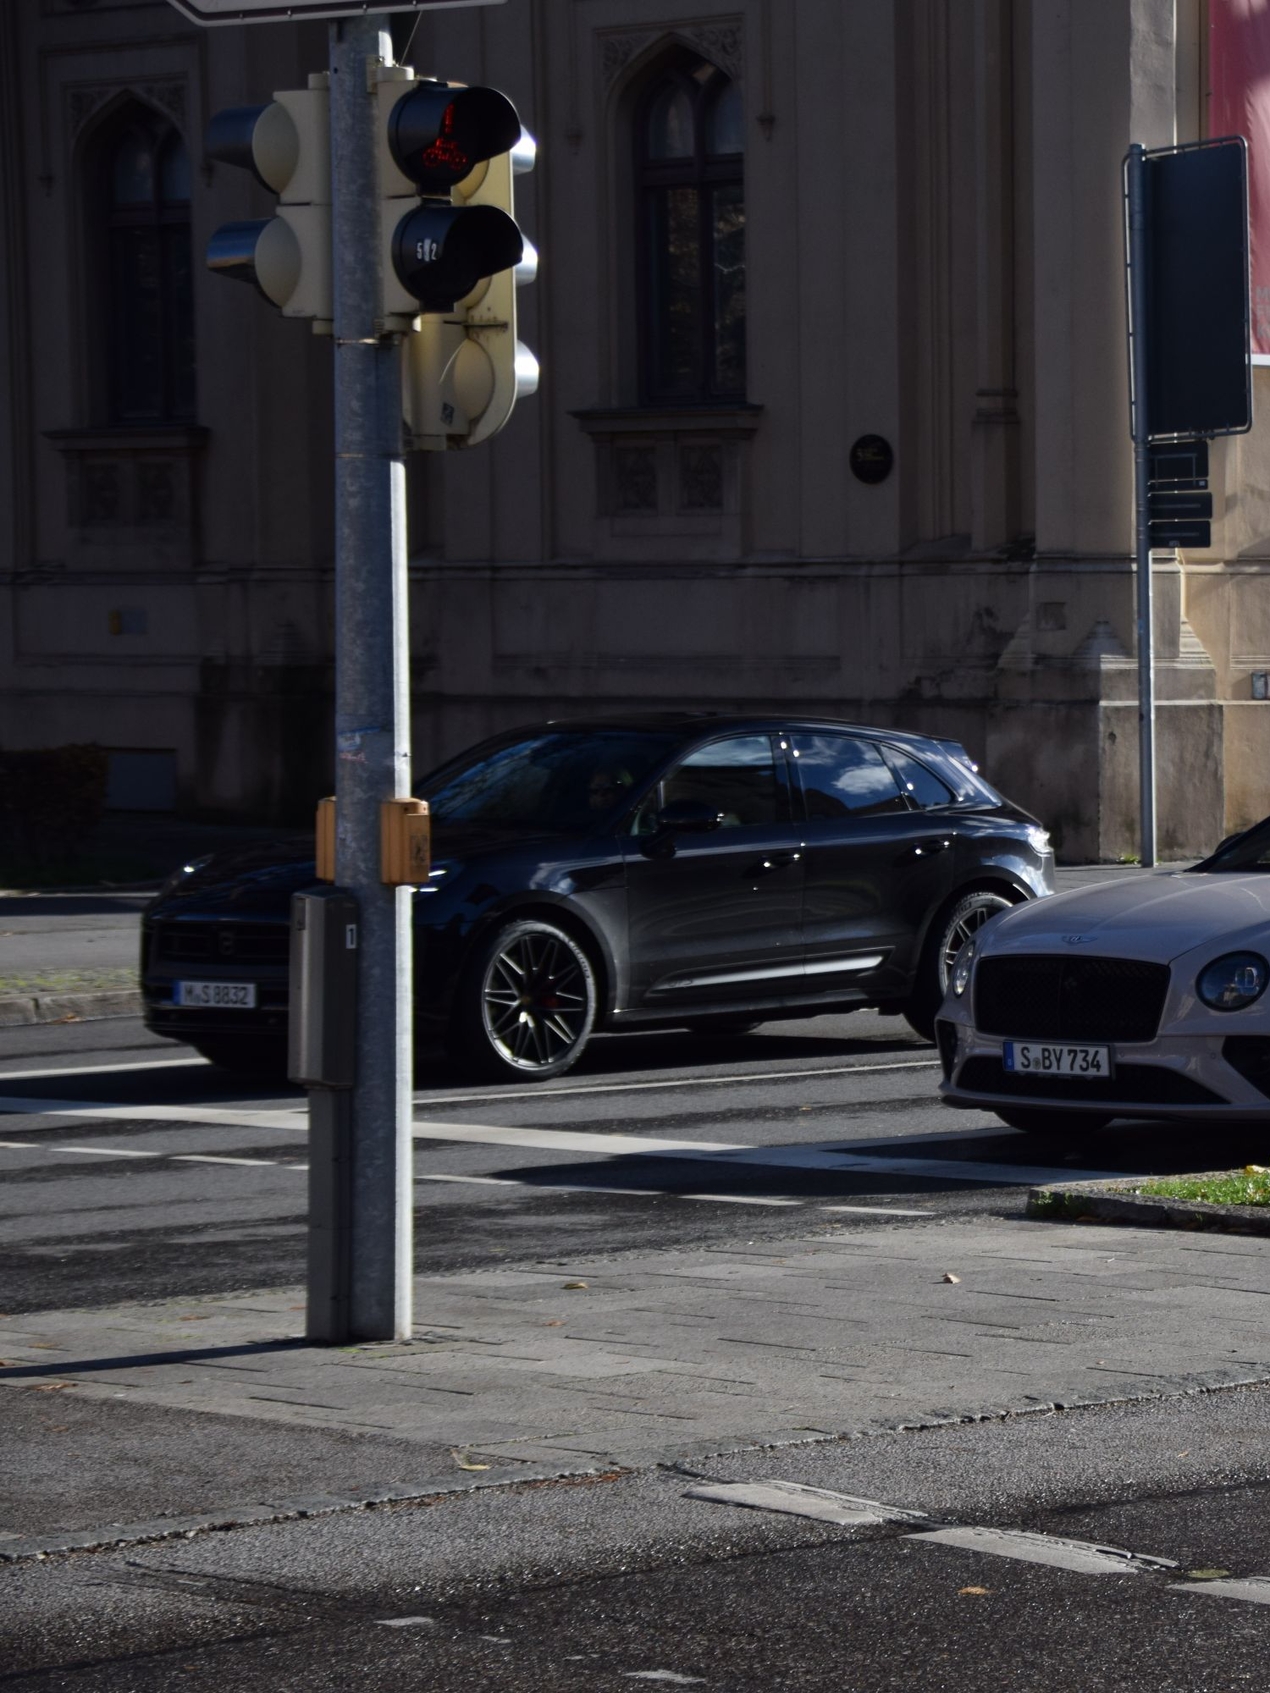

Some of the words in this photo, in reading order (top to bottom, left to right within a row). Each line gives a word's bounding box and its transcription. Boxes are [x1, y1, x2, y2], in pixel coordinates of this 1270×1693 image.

[213, 985, 248, 1005] 8832
[1041, 1047, 1063, 1071] BY
[1067, 1049, 1101, 1072] 734
